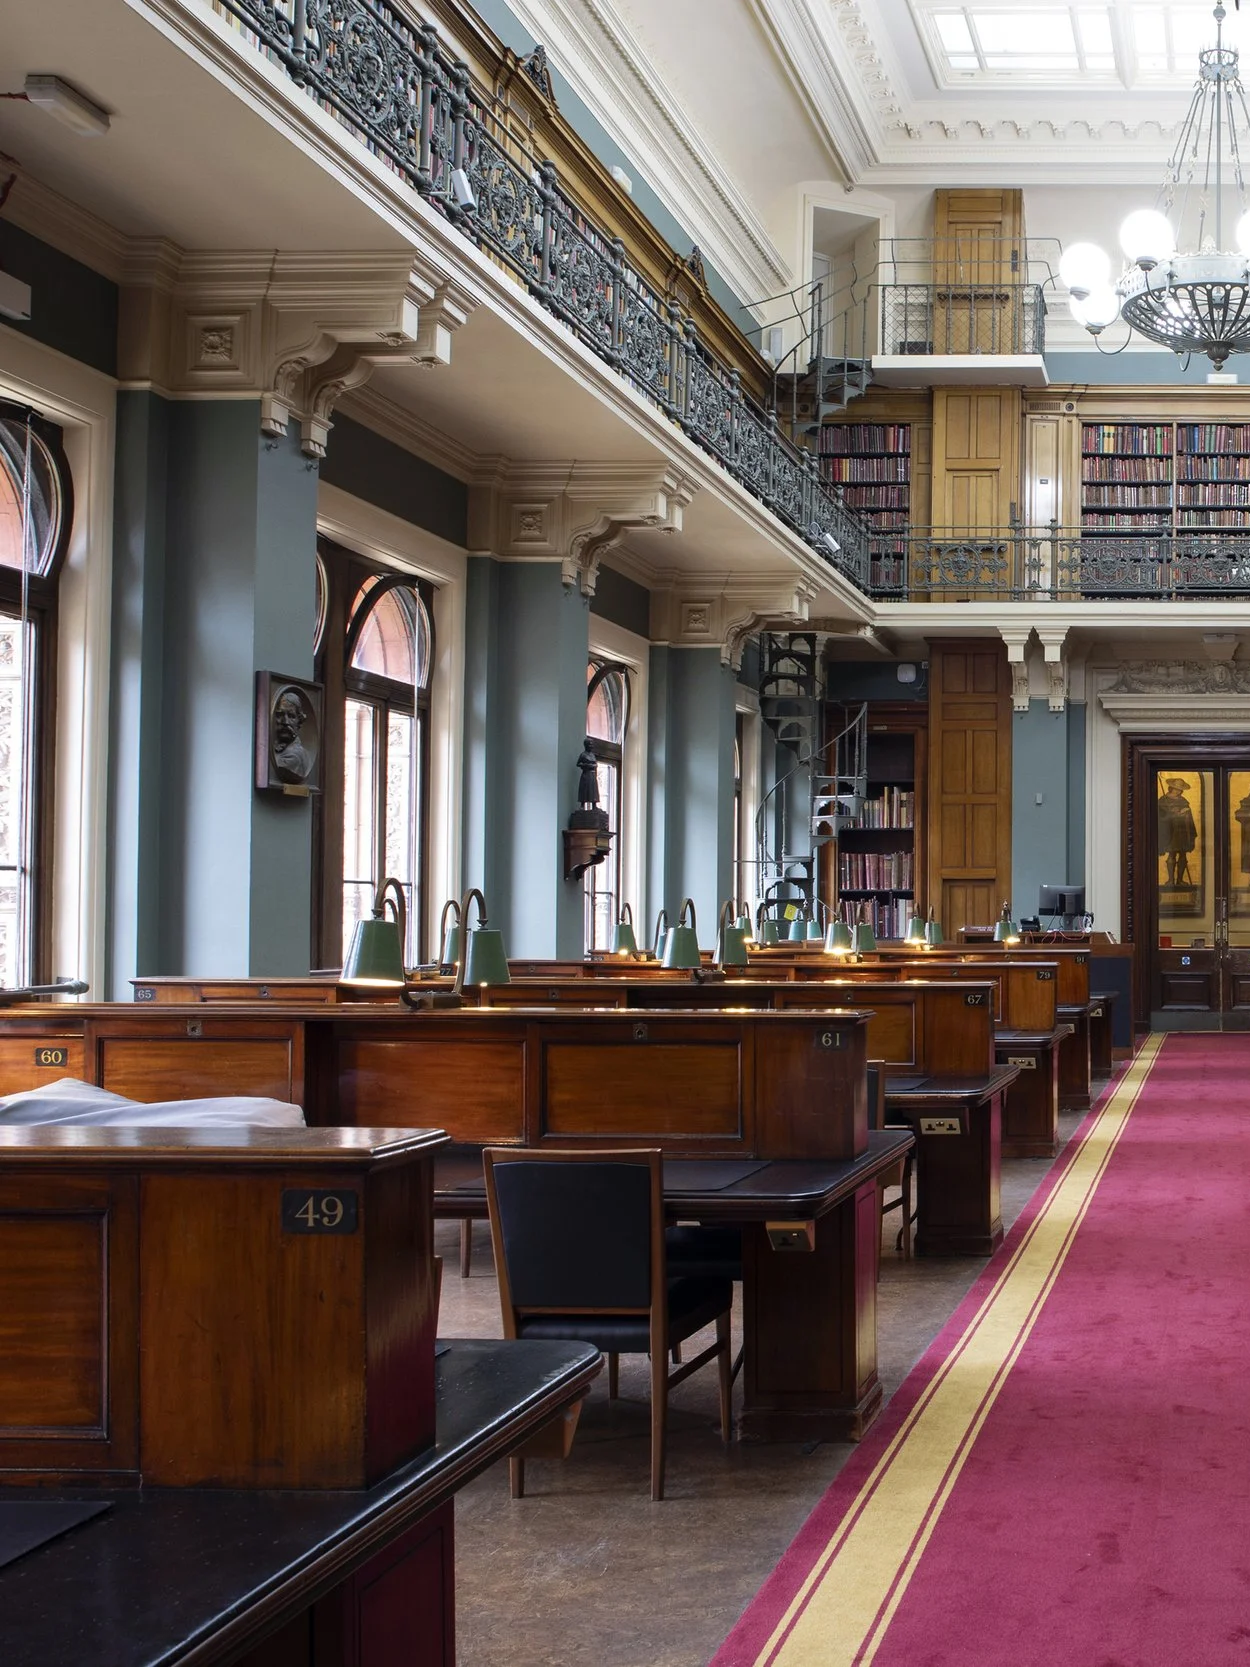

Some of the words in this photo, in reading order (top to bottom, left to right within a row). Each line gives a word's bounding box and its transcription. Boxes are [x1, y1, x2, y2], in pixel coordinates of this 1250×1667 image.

[1076, 955, 1085, 963] 91
[1039, 971, 1050, 979] 79
[138, 989, 152, 999] 65
[967, 994, 982, 1004] 67
[822, 1032, 841, 1047] 61
[41, 1051, 63, 1064] 60
[294, 1196, 344, 1227] 49
